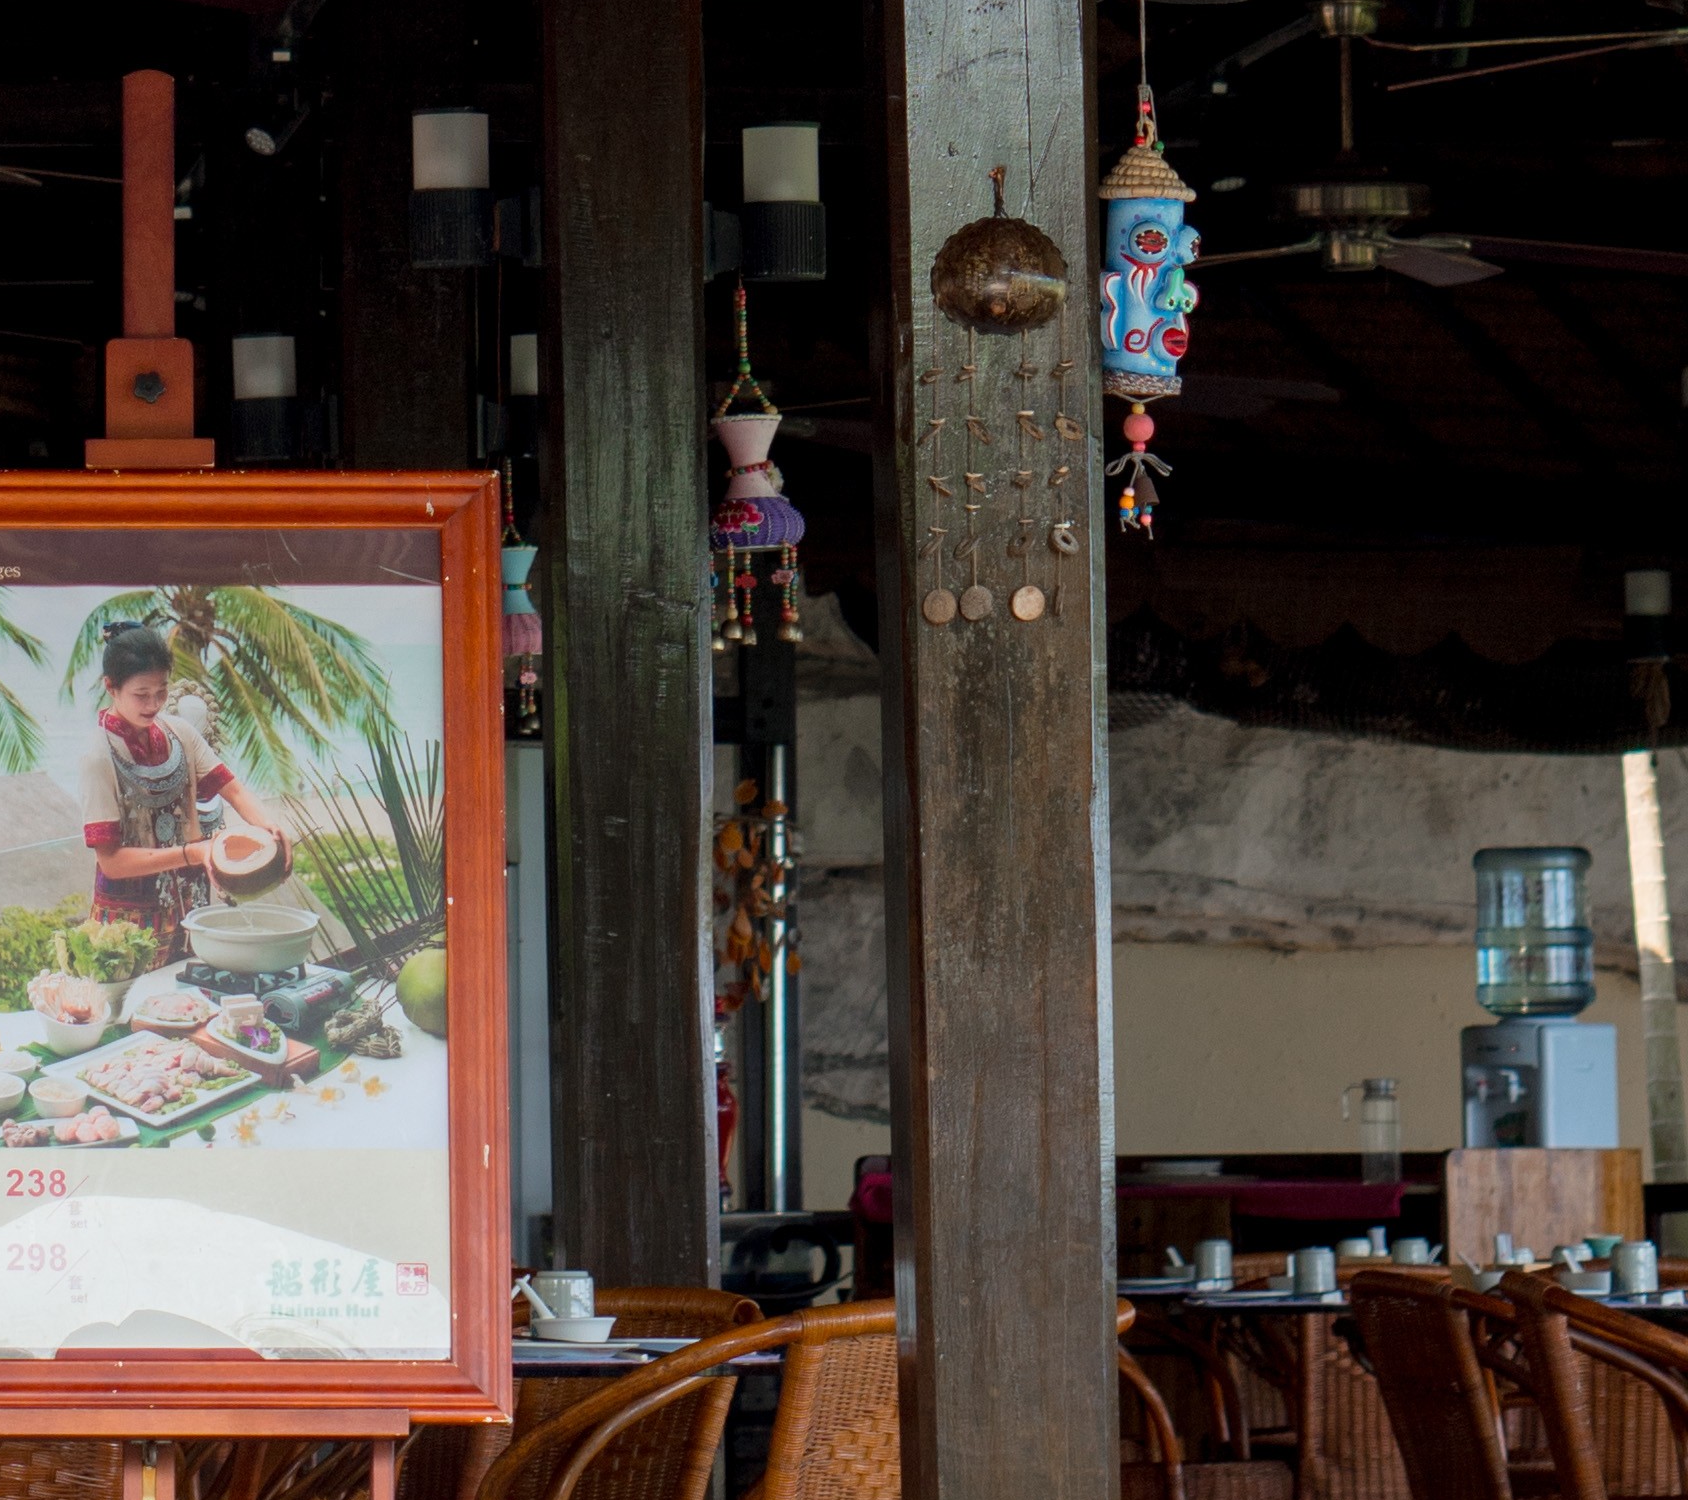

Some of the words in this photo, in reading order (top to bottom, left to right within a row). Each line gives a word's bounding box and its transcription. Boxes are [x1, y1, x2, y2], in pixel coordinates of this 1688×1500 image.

[5, 1169, 67, 1198] 238
[70, 1218, 89, 1229] set
[5, 1243, 68, 1272] 298
[265, 1257, 384, 1298] 船形屋
[70, 1293, 89, 1304] set
[270, 1303, 339, 1318] Hainan
[346, 1303, 381, 1318] Hut
